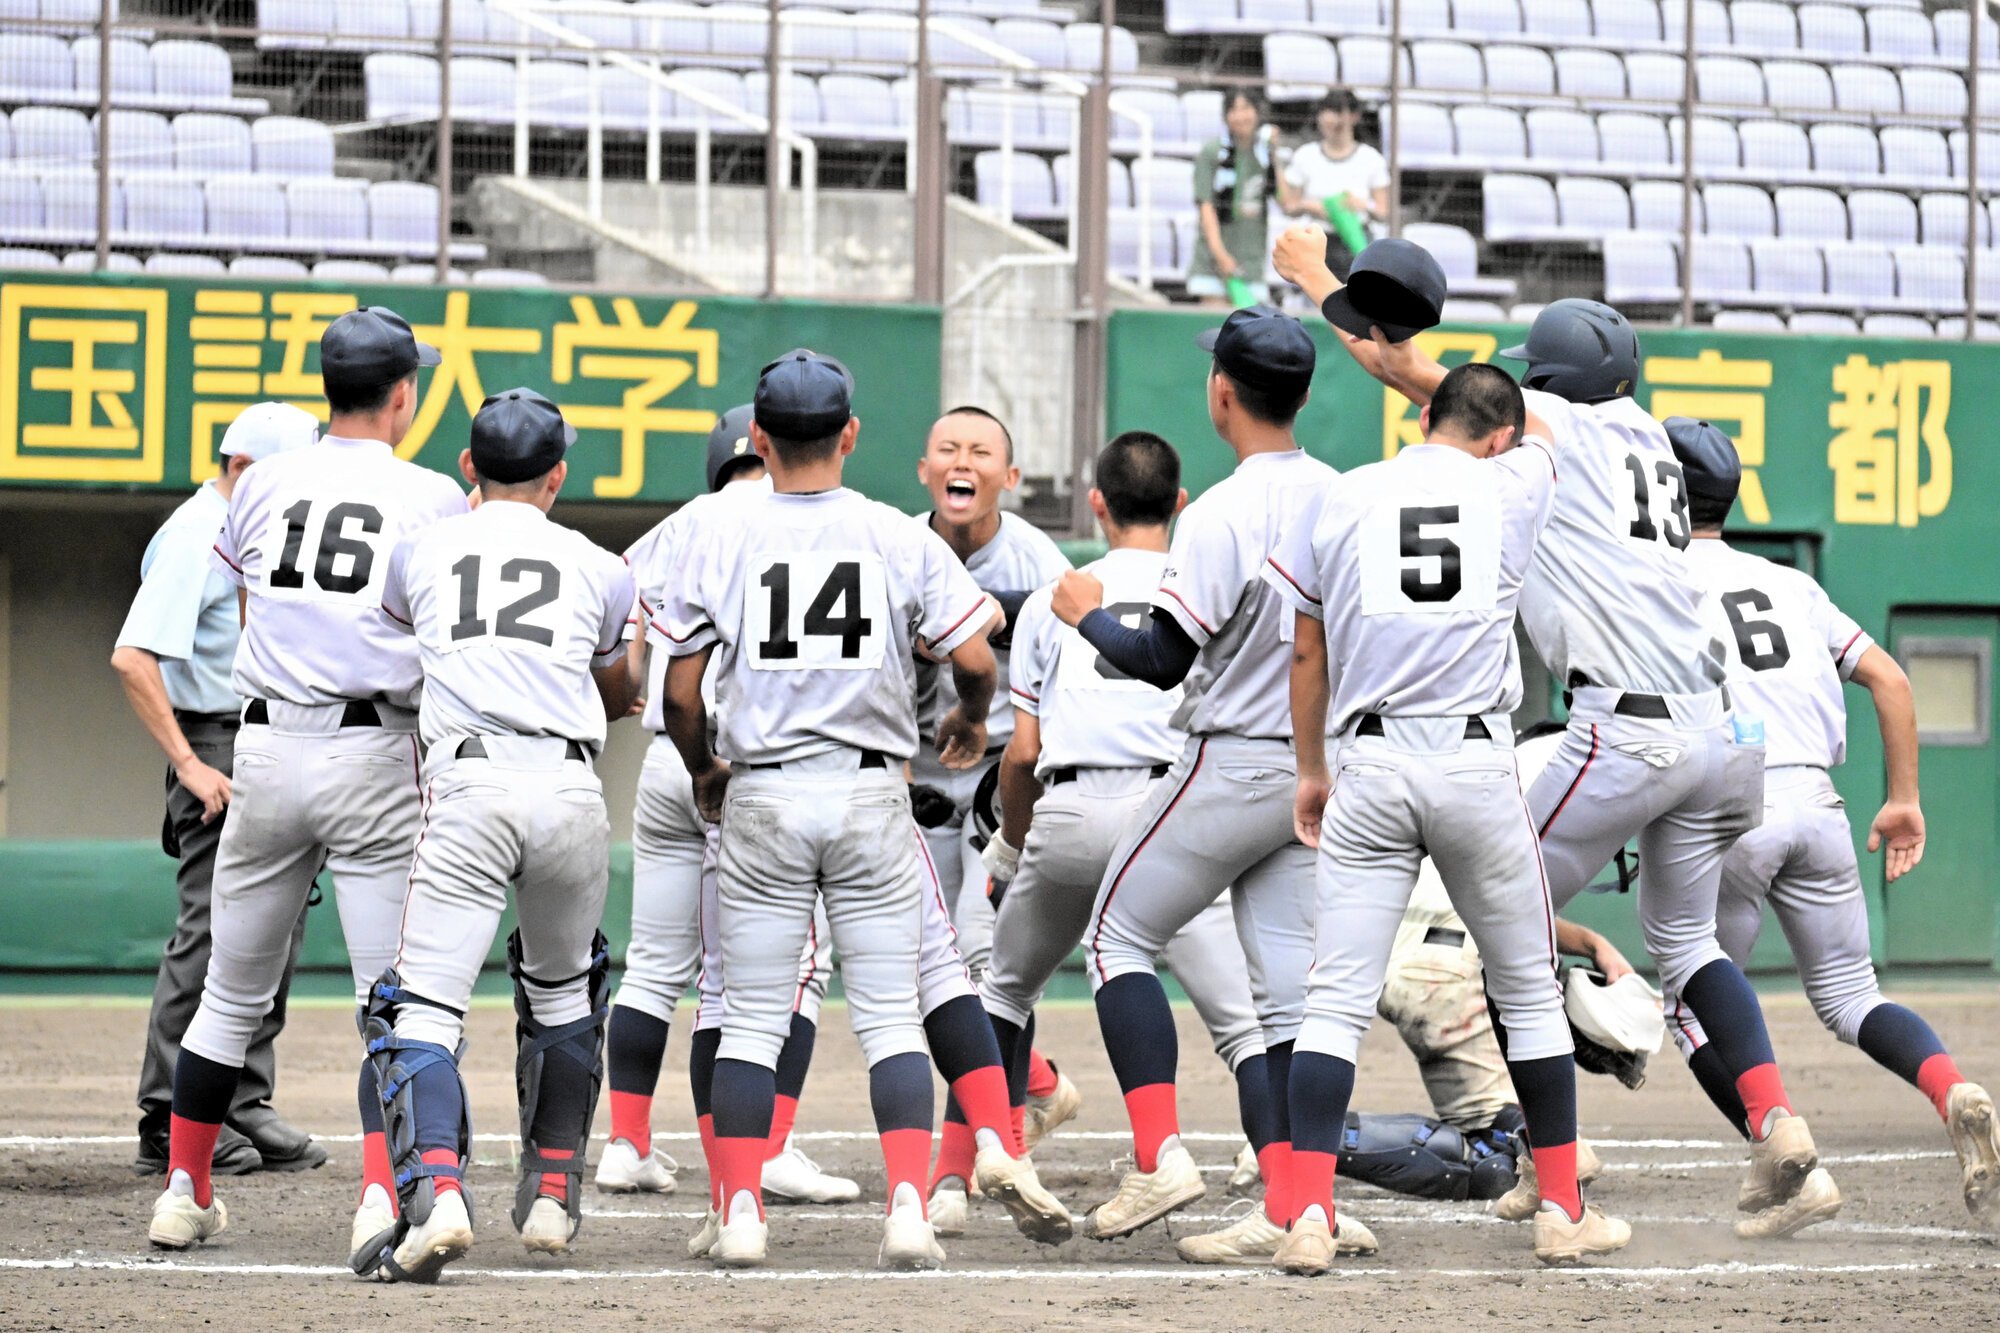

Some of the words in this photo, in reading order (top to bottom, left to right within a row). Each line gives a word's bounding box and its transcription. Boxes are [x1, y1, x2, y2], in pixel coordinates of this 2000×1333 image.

[270, 500, 383, 594] 16
[1625, 453, 1691, 551] 13
[450, 554, 561, 647] 12
[1400, 505, 1462, 602] 5
[759, 562, 871, 660] 14
[1720, 588, 1791, 672] 6
